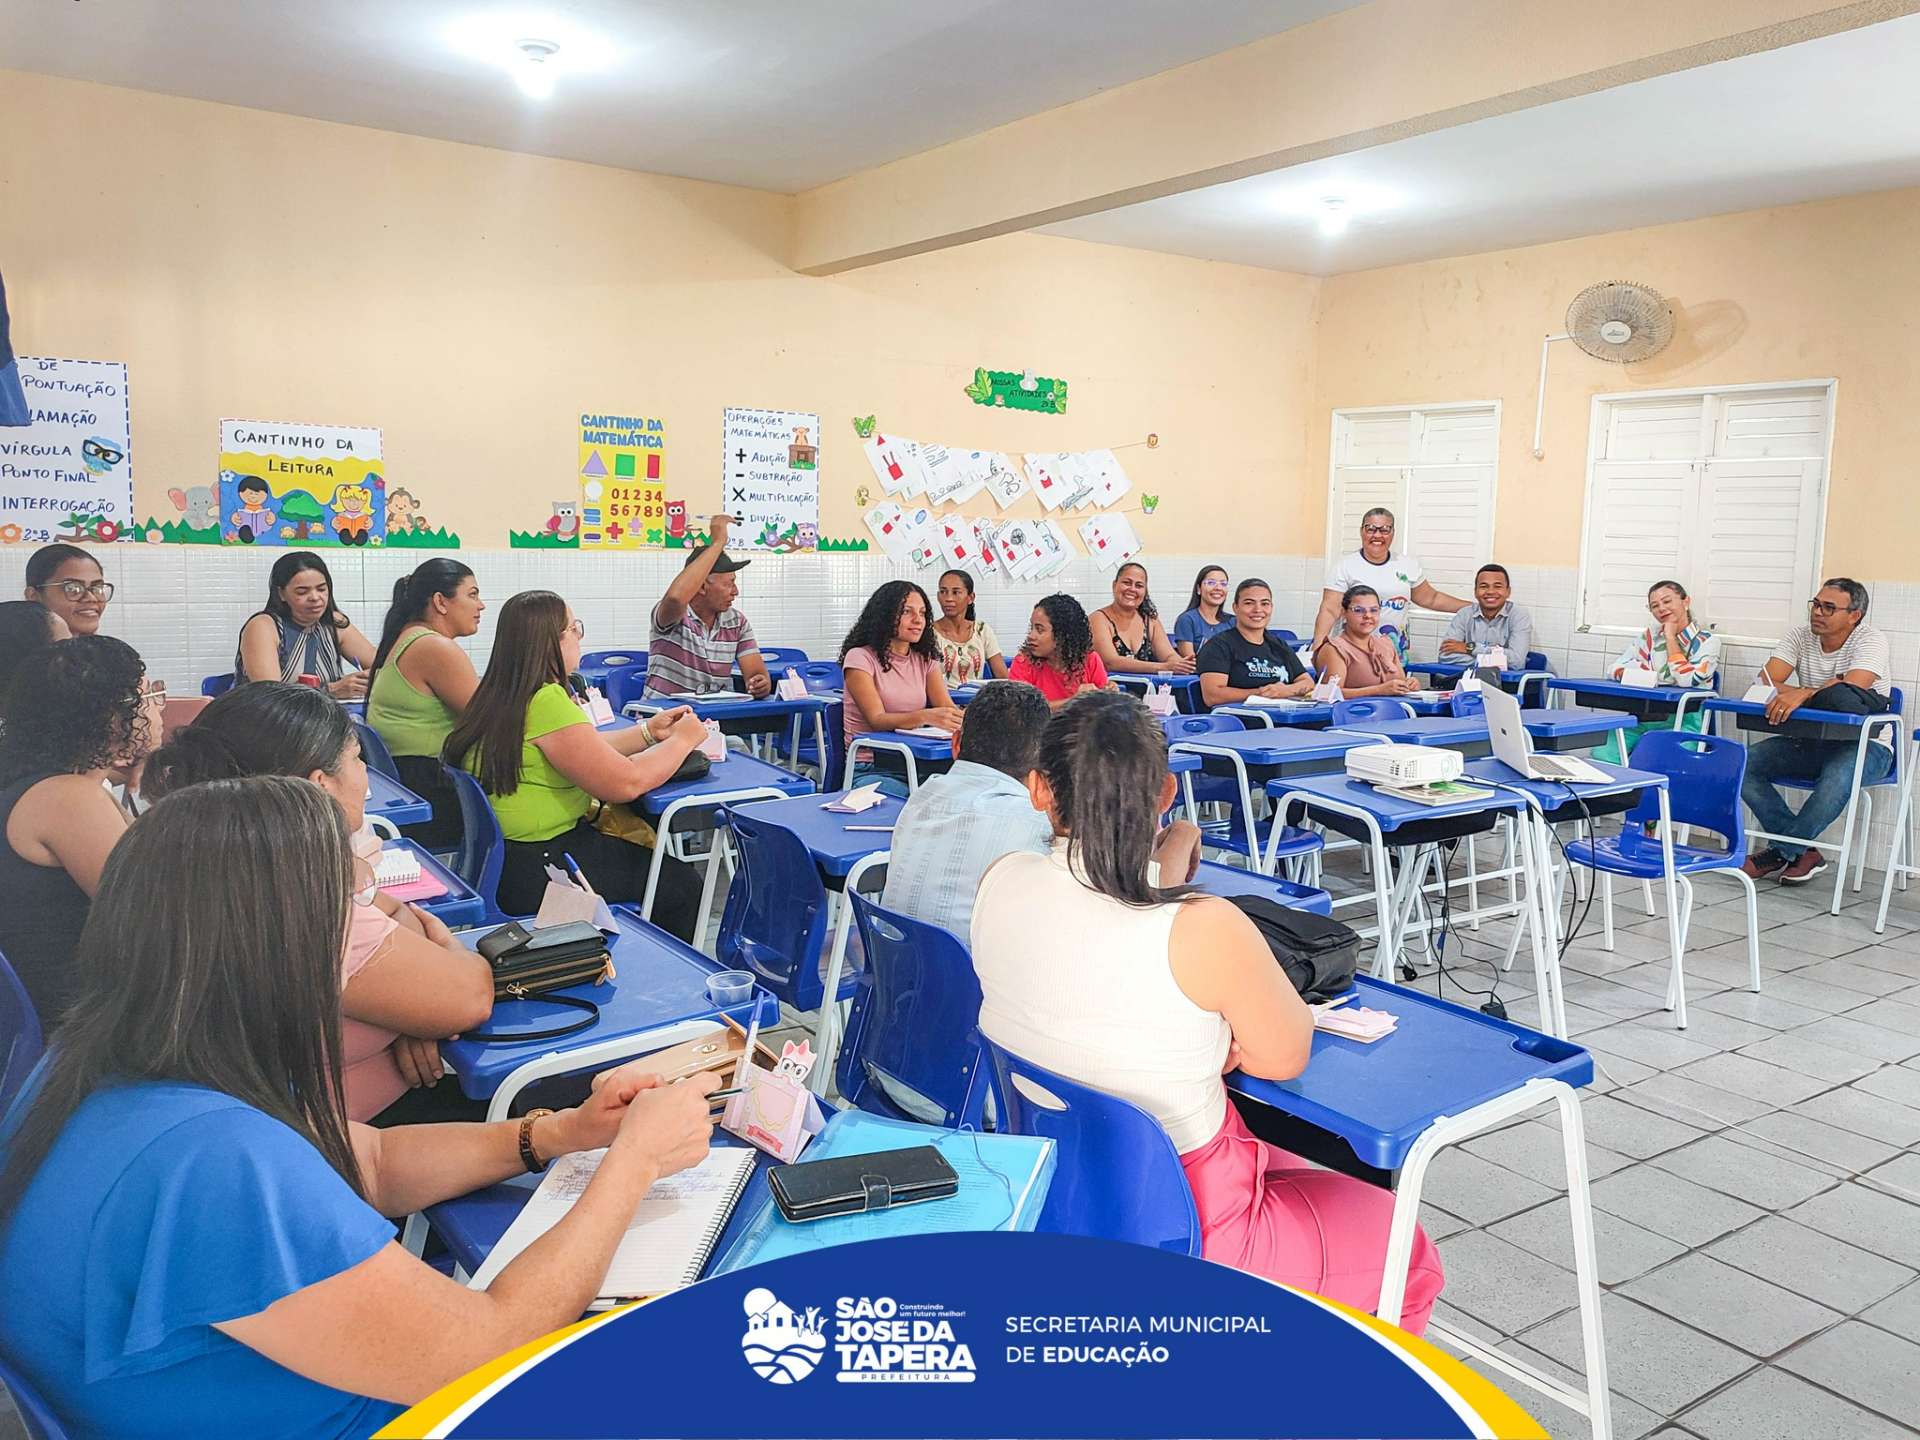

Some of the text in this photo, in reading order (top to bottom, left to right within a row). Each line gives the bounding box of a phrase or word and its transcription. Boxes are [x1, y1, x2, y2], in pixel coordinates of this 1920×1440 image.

[39, 361, 58, 371] DE
[21, 374, 116, 399] PONTUAÇÃO
[29, 409, 97, 428] LAMAÇÃO
[581, 414, 664, 432] CANTINHO DA
[728, 412, 783, 429] OPERAÇÕES
[234, 429, 354, 451] CANTINHO DA
[583, 430, 664, 448] MATEMÁTICA
[731, 427, 791, 440] MATEMÁTICAS
[1, 441, 72, 456] VÍRGULA
[751, 452, 787, 466] ADIÇÃO
[1, 463, 97, 484] PONTO FINAL
[268, 459, 333, 477] LEITURA
[749, 471, 803, 486] SUBTRAÇÃO
[2, 495, 115, 515] INTERROGAÇÃO
[749, 491, 815, 507] MULTIPLICAÇÃO
[750, 513, 786, 523] DIVISÃO
